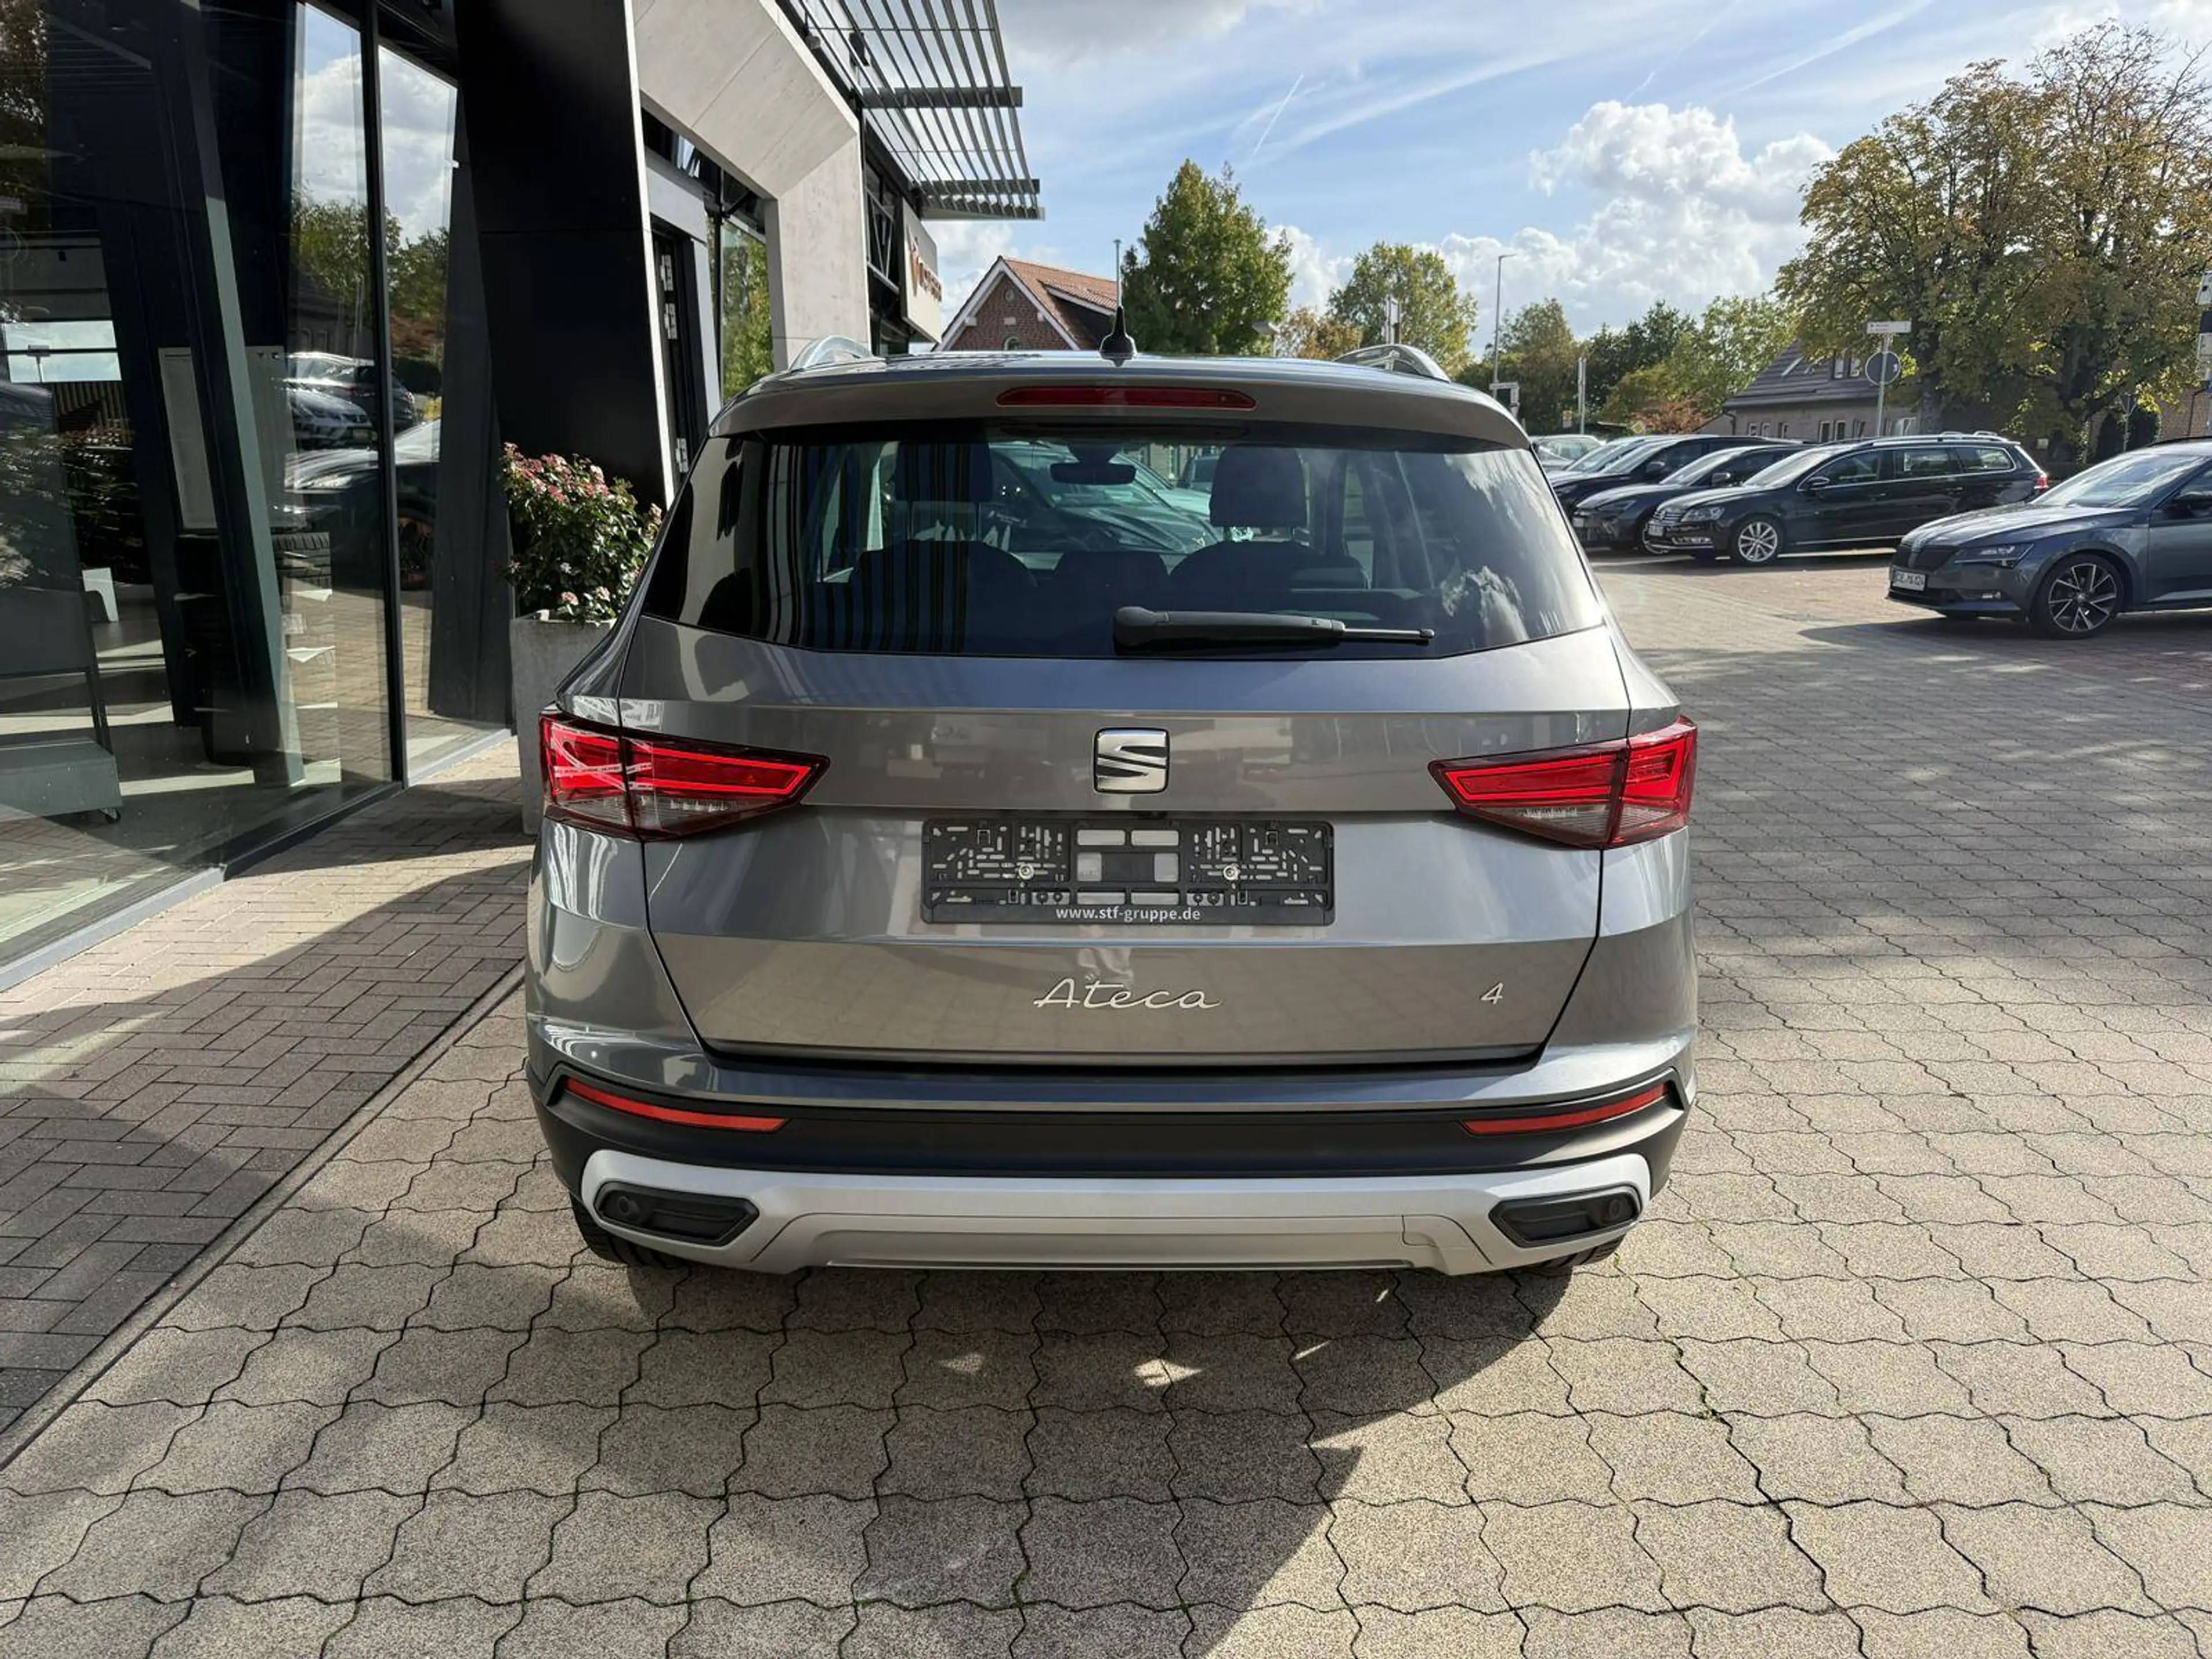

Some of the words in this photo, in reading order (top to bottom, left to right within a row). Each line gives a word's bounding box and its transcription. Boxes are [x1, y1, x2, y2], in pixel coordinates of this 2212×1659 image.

[1056, 906, 1201, 922] www.stf-gruppe.de
[1033, 978, 1222, 1008] Ateca
[1481, 982, 1503, 1005] 4
